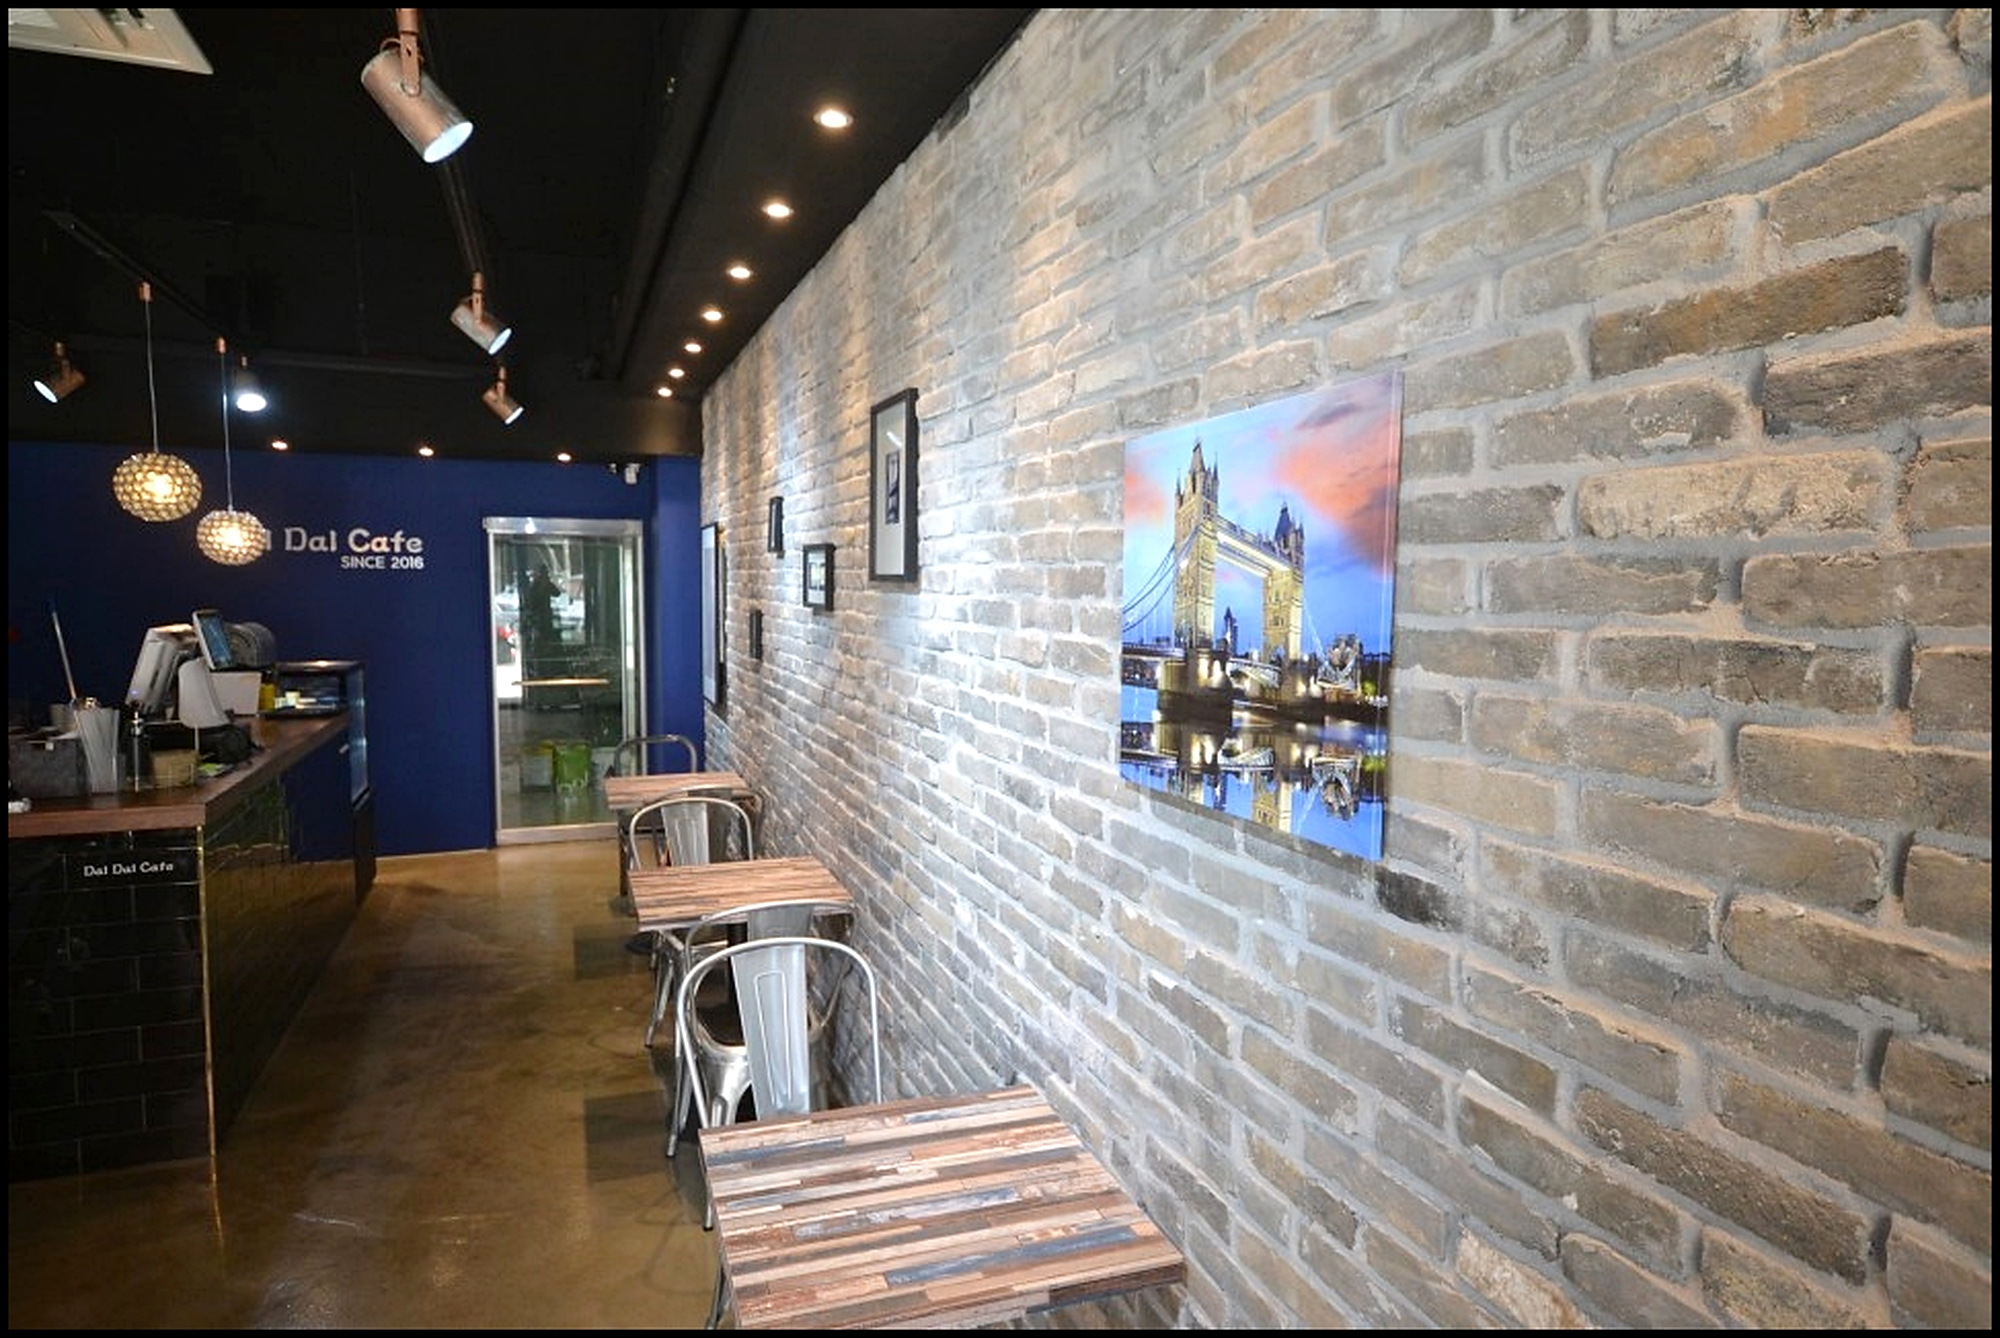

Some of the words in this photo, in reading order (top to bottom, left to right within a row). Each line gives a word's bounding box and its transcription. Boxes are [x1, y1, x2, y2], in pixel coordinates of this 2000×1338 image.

[284, 527, 337, 553] Dal
[348, 528, 424, 553] Cafe
[340, 556, 385, 570] SINCE
[390, 556, 424, 570] 2016
[83, 865, 108, 878] Dal
[112, 863, 137, 875] Dal
[140, 861, 174, 873] Cafe
